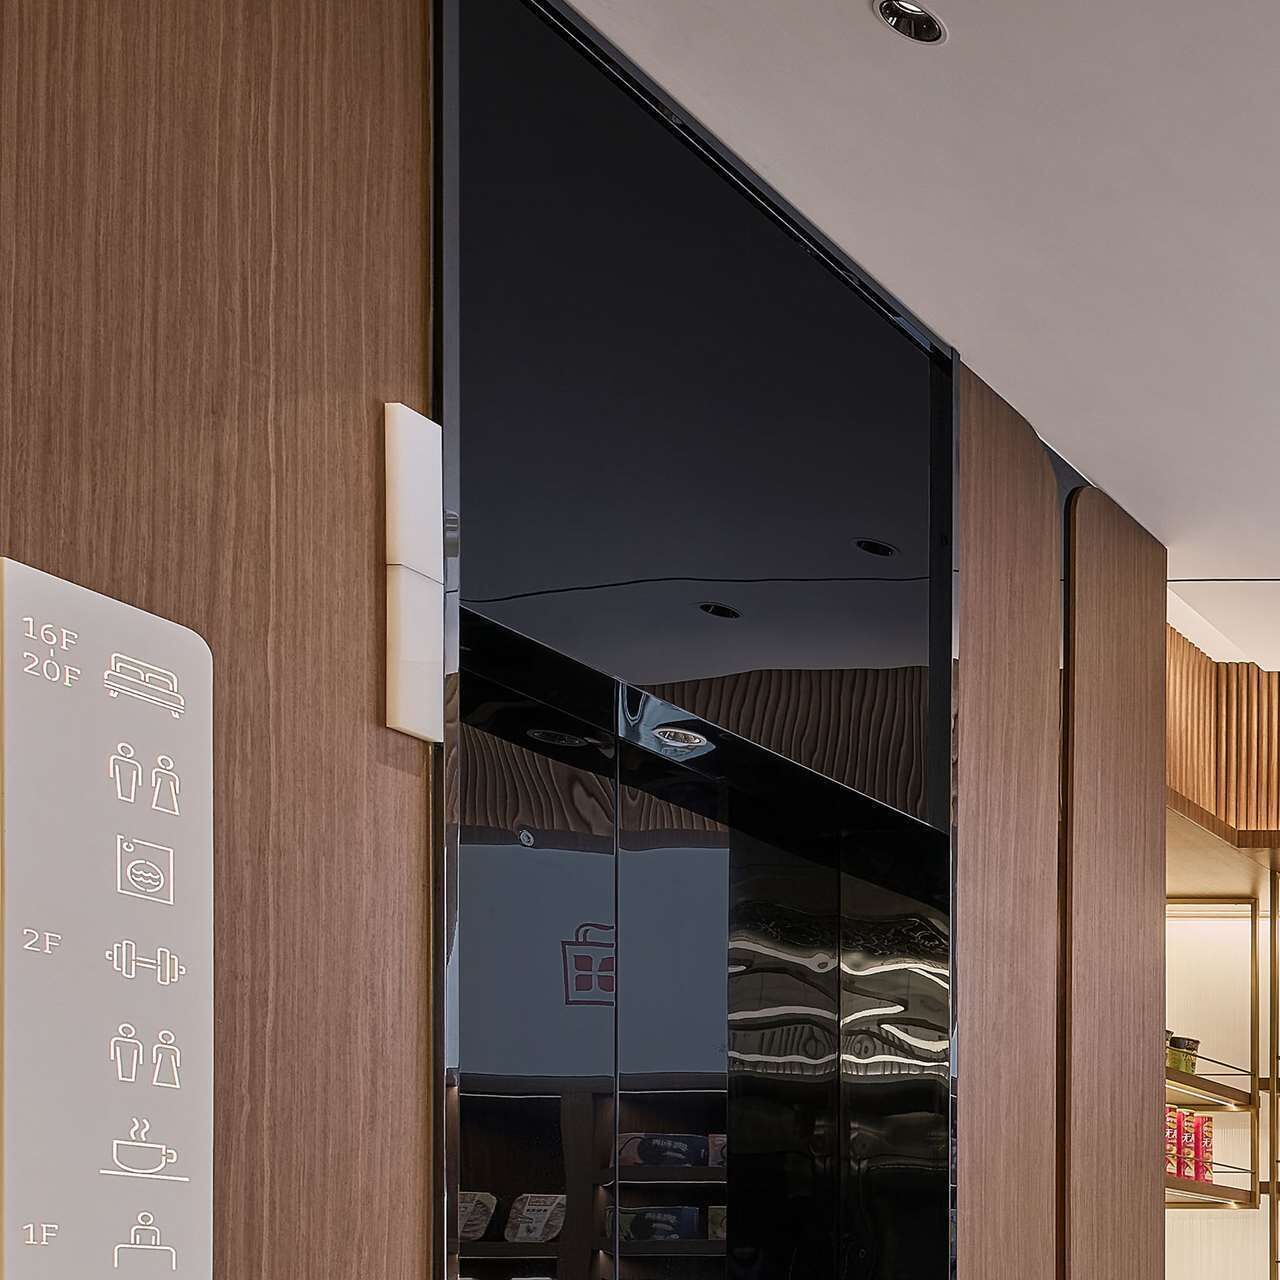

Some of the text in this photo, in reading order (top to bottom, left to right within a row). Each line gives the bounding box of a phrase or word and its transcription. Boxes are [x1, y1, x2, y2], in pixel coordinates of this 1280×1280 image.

[22, 616, 79, 651] 16F
[23, 651, 81, 687] 20F
[23, 928, 62, 954] 2F
[22, 1223, 59, 1245] 1F
